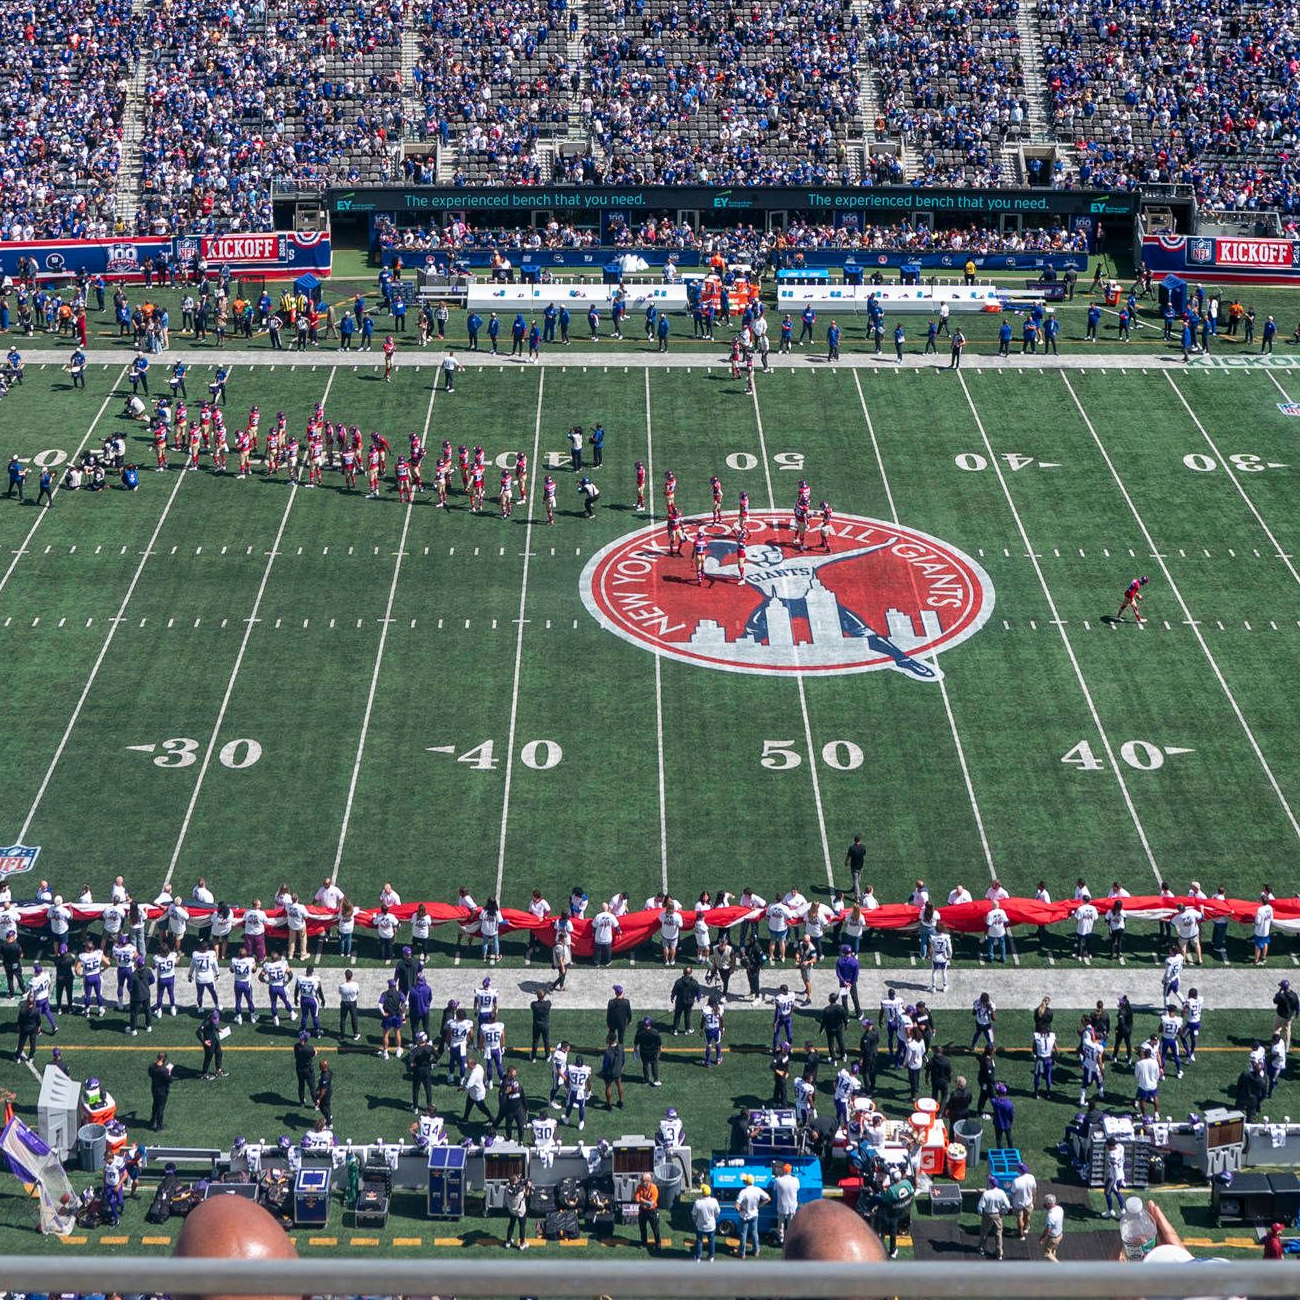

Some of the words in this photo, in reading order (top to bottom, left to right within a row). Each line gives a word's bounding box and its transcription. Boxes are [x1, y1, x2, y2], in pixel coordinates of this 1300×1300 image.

[405, 194, 428, 206] The
[431, 195, 509, 208] experienced
[512, 194, 551, 207] bench
[554, 195, 580, 207] that
[584, 196, 607, 209] you
[611, 194, 646, 206] need.
[808, 194, 831, 207] The
[835, 194, 912, 210] experienced
[915, 195, 953, 207] bench
[958, 196, 983, 208] that
[987, 198, 1011, 211] you
[1014, 198, 1050, 210] need.
[205, 237, 273, 260] KICKOFF
[1220, 241, 1288, 263] KICKOFF
[1292, 245, 1300, 264] 2024
[724, 451, 805, 471] 50
[954, 452, 1034, 471] 40
[1182, 453, 1266, 472] 30
[686, 518, 875, 544] FOOTALL
[612, 540, 672, 586] YORK
[747, 565, 810, 583] GIANTS
[890, 542, 962, 611] GIANTS
[613, 593, 686, 637] NEW
[153, 737, 264, 769] 30
[457, 739, 564, 770] 40
[760, 739, 865, 770] 50
[1060, 739, 1164, 770] 40
[196, 959, 212, 970] 71
[480, 996, 492, 1006] 19
[423, 1124, 439, 1136] 34
[536, 1128, 552, 1140] 30
[666, 1128, 676, 1142] 3
